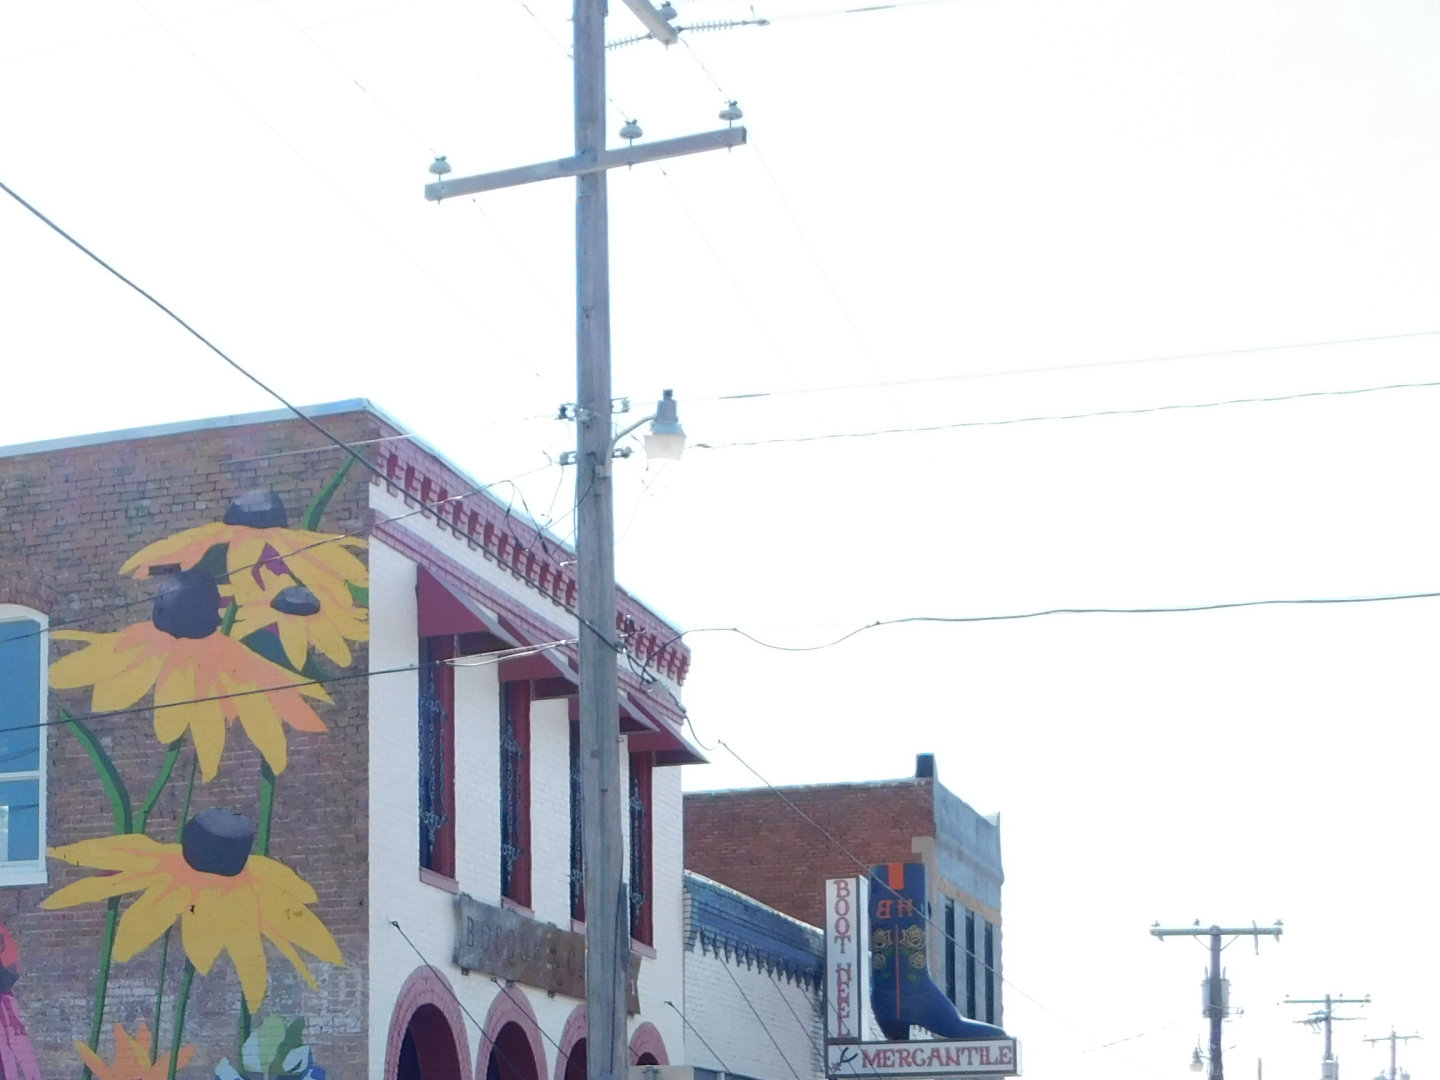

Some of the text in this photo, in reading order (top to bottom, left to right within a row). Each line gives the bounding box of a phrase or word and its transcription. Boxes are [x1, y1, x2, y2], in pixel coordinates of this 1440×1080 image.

[833, 880, 851, 1038] BOOT HEEL
[861, 1044, 1013, 1070] MERCANTILE
